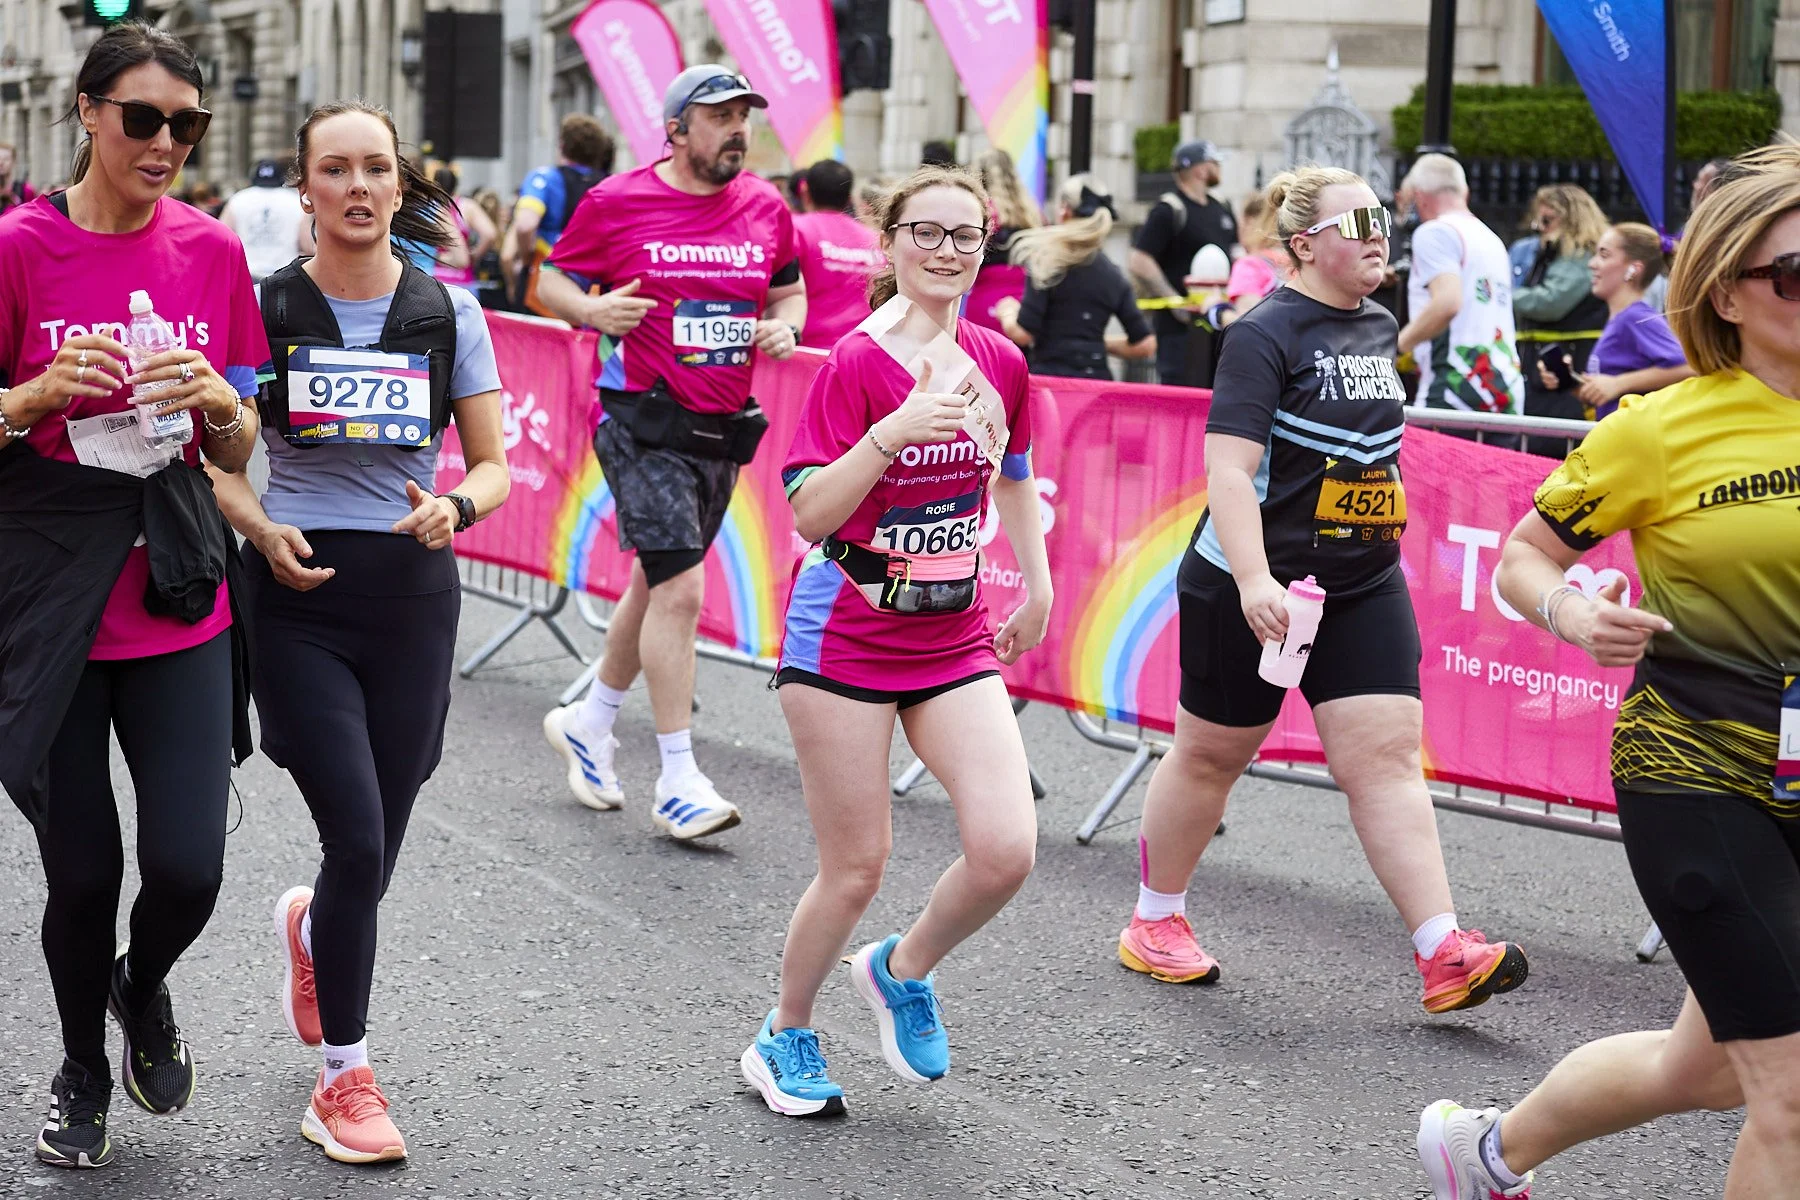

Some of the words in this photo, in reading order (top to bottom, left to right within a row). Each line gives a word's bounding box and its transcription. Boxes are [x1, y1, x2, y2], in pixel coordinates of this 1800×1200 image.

[1594, 1, 1630, 62] Smith
[643, 241, 766, 268] Tommy's
[705, 303, 731, 313] CRAIG
[683, 321, 752, 342] 11956
[308, 375, 409, 410] 9278
[890, 438, 988, 467] ommy
[880, 474, 896, 484] The
[897, 475, 941, 487] pregnancy
[942, 471, 958, 481] and
[959, 470, 976, 479] bab
[1361, 470, 1387, 480] LAURYN
[1698, 465, 1800, 508] LONDON
[925, 502, 957, 515] ROSIE
[1335, 489, 1395, 517] 4521
[882, 516, 978, 555] 10665
[980, 563, 1027, 590] char
[1441, 645, 1482, 679] The
[1488, 660, 1619, 710] pregnancy
